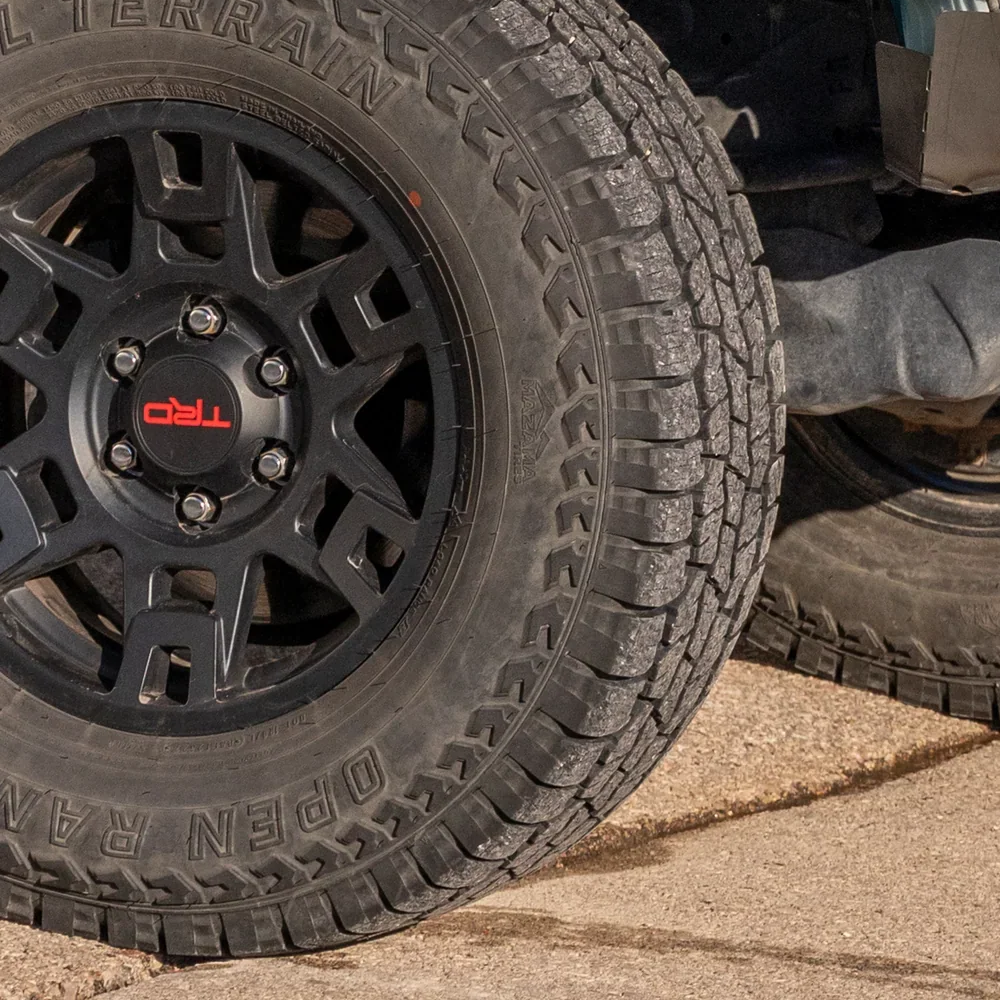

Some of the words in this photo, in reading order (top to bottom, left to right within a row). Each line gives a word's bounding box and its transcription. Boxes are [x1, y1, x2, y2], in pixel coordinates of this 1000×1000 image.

[143, 396, 232, 429] TRD
[521, 379, 537, 484] MAZAMA
[188, 745, 388, 862] OPEN
